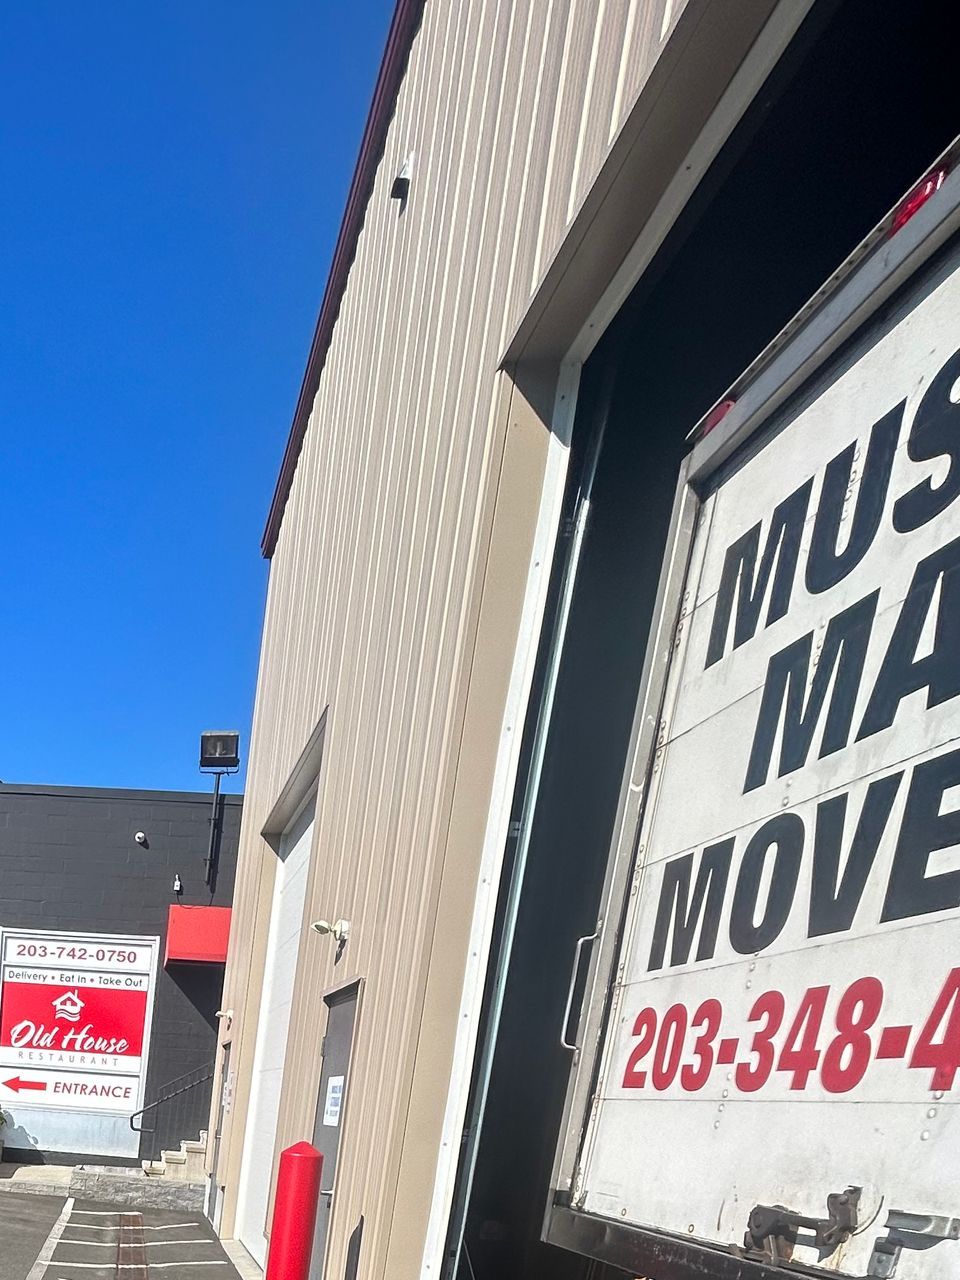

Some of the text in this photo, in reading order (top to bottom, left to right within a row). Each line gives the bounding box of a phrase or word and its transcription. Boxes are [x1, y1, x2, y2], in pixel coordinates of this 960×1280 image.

[647, 750, 960, 972] MOVE
[16, 944, 137, 963] 203-742-0750
[8, 970, 142, 987] Delivery Eat In Take Out
[10, 1019, 129, 1053] Old House
[622, 967, 960, 1094] 203-348-4
[18, 1051, 118, 1066] RESTAURANT
[53, 1082, 132, 1099] ENTRANCE
